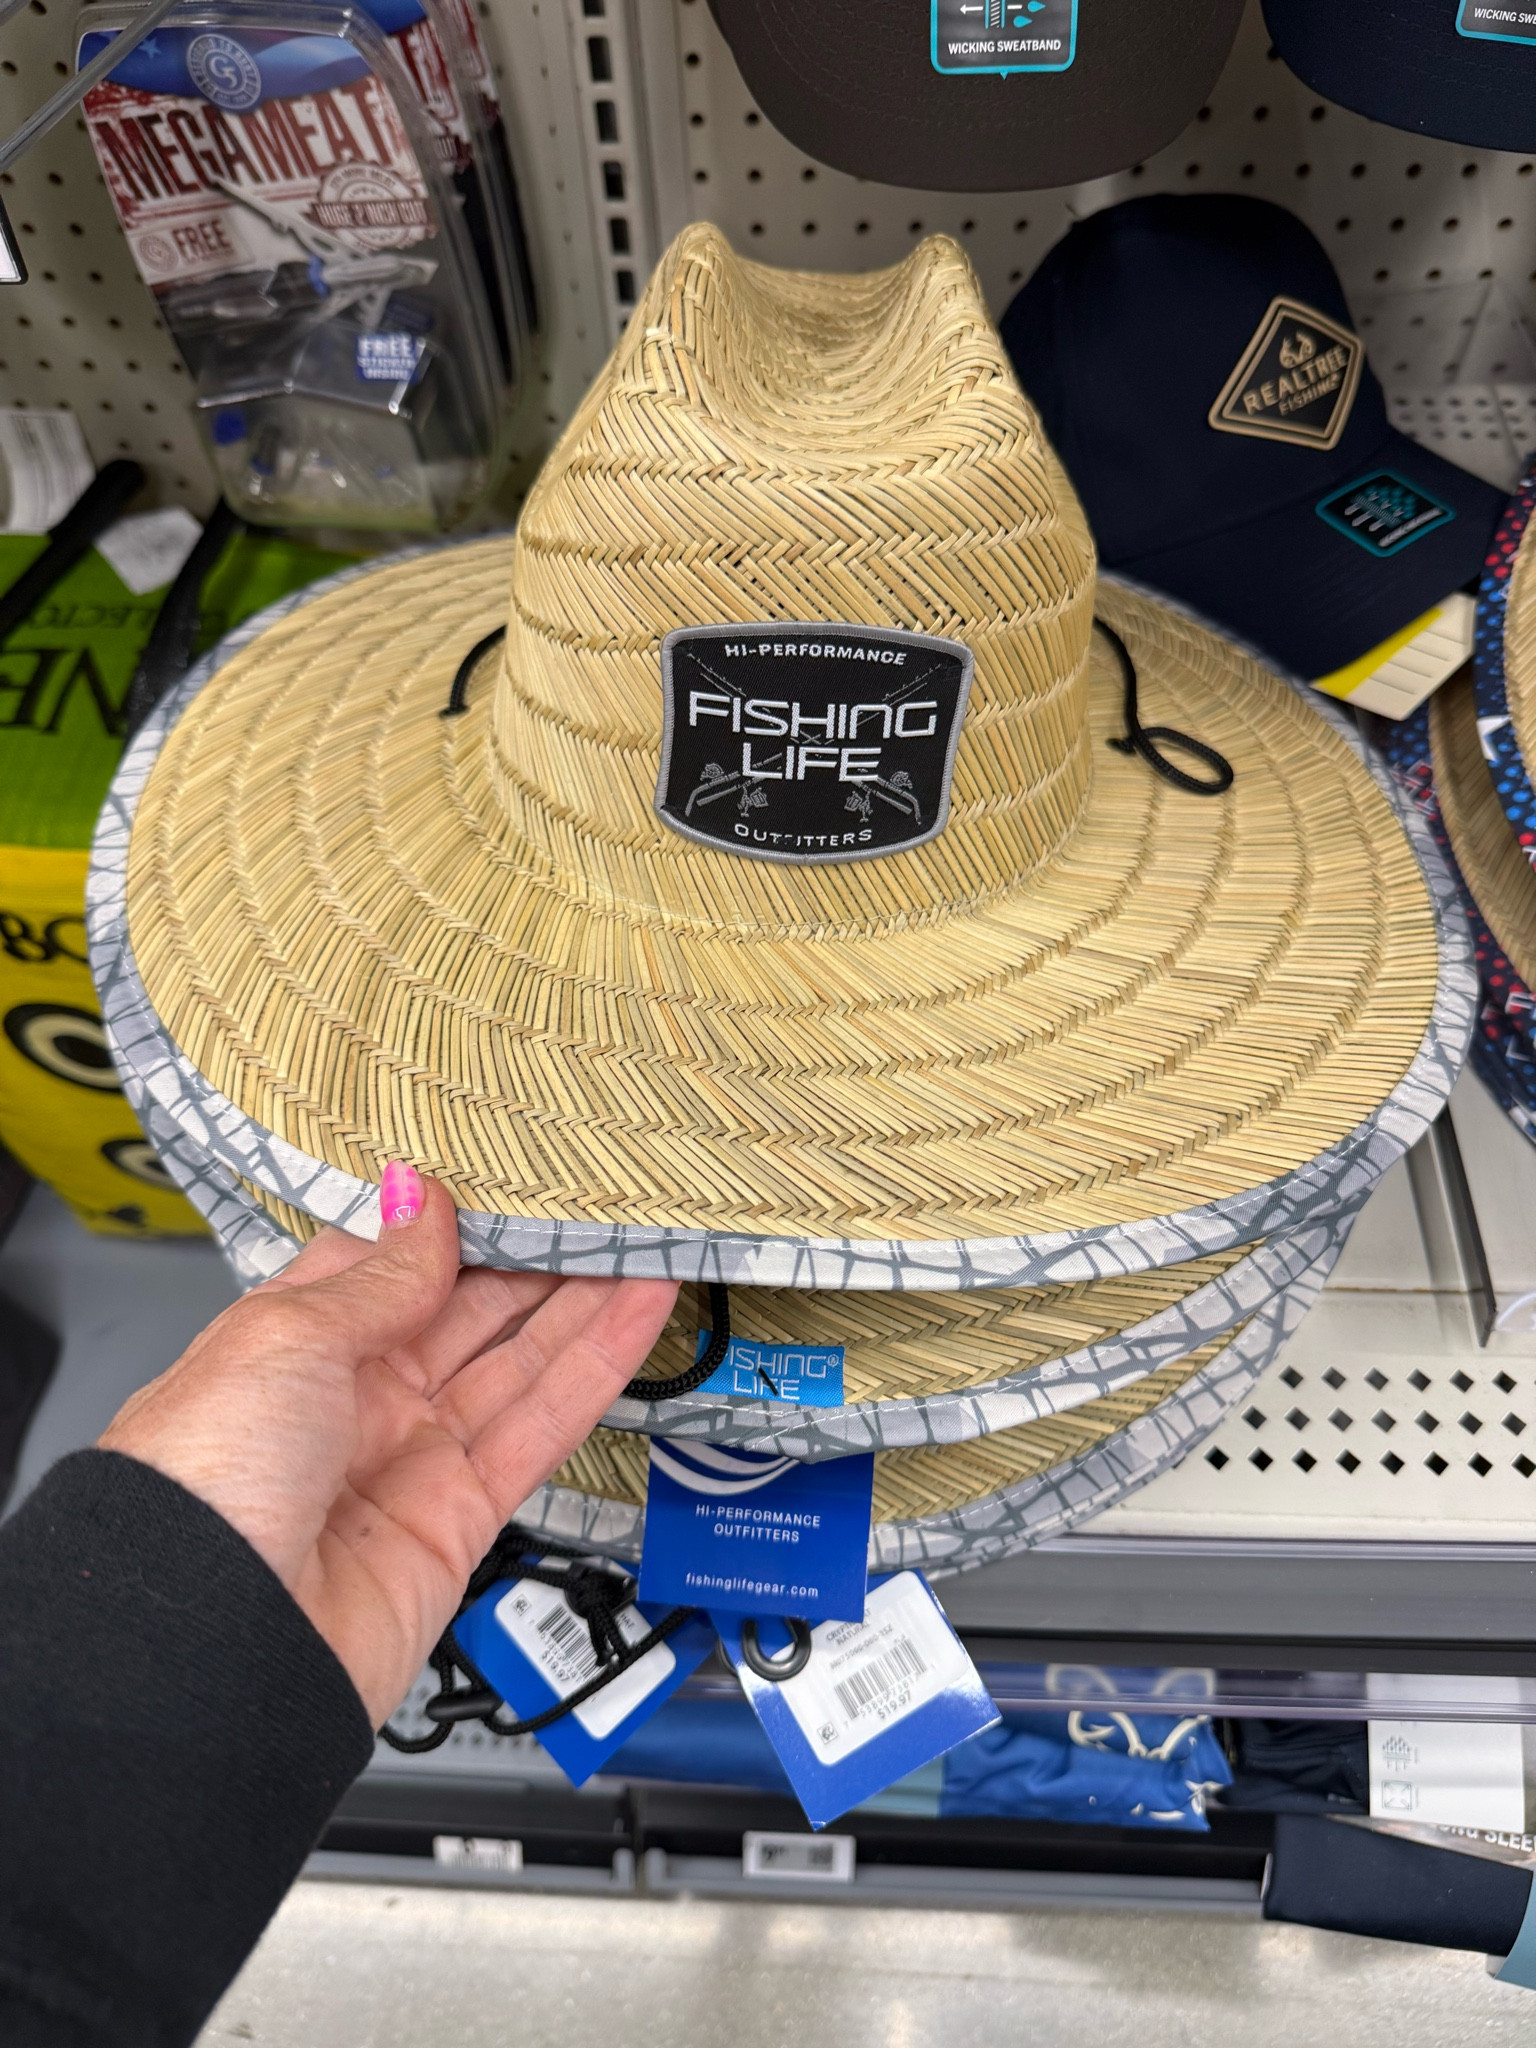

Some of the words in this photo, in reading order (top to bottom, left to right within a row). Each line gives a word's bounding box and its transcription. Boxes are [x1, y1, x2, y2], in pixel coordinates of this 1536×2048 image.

[1474, 7, 1517, 22] WICKING
[948, 41, 995, 54] WICKING
[997, 39, 1062, 52] SWEATBAND
[171, 218, 232, 261] FREE
[358, 332, 413, 358] FREE
[1243, 344, 1349, 416] REALTREE
[725, 643, 907, 666] HI-PERFORMANCE
[689, 690, 938, 740] FISHING
[742, 742, 882, 782] LIFE
[733, 1370, 801, 1401] LIFE
[695, 1504, 821, 1528] HI-PERFORMANCE
[714, 1523, 800, 1543] OUTFITTERS
[685, 1572, 819, 1598] fishinglifegear.com
[541, 1652, 571, 1683] $19.97
[877, 1690, 912, 1720] $19.97
